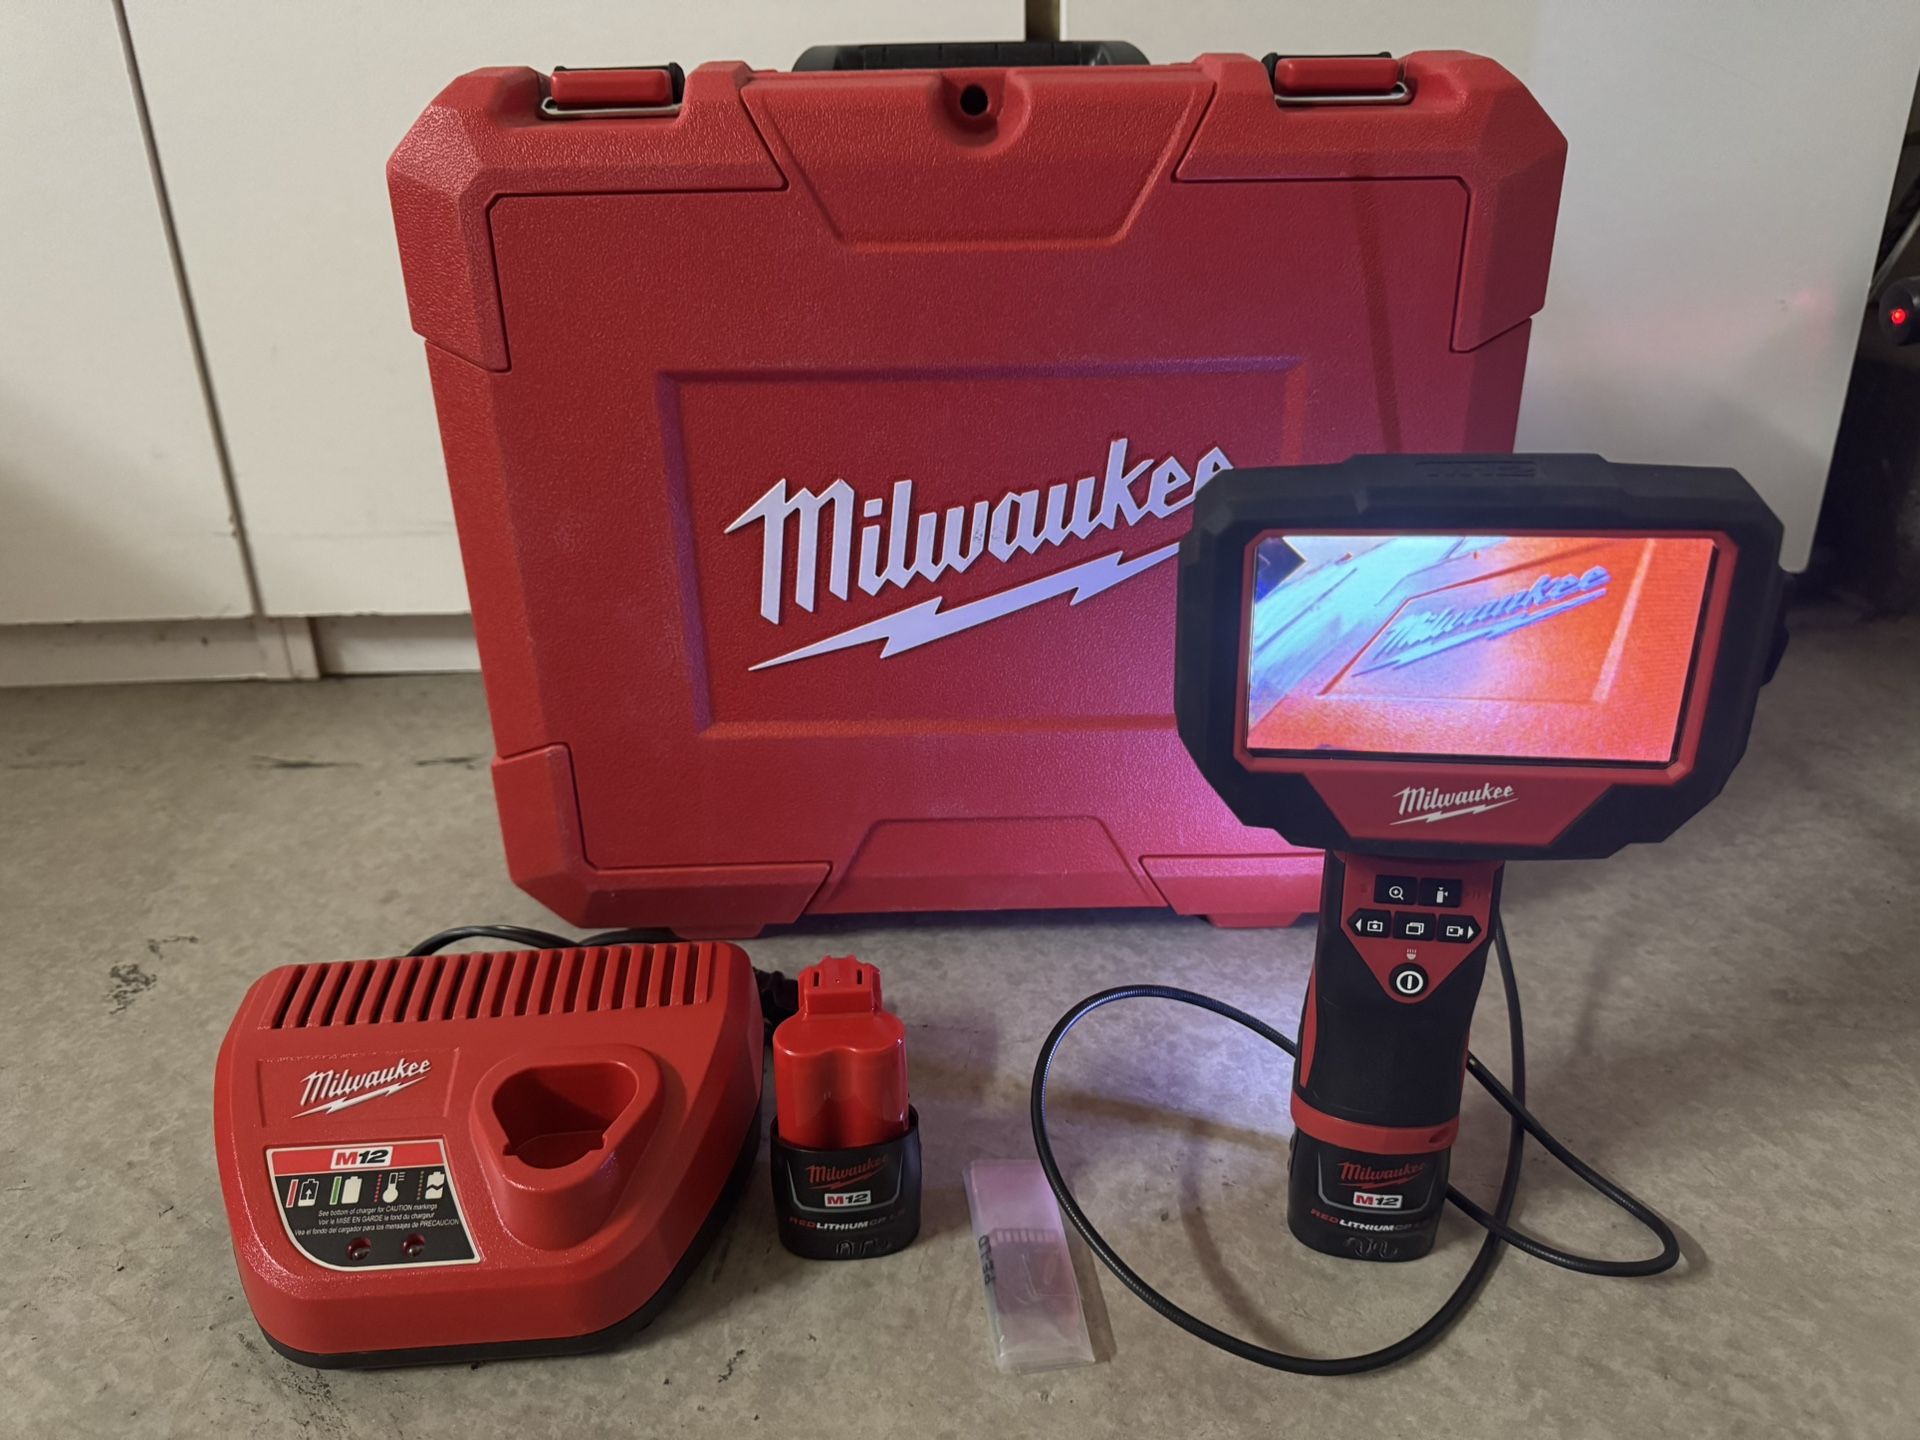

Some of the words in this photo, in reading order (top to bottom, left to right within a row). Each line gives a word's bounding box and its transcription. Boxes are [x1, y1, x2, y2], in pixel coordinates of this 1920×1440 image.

[1392, 782, 1515, 816] Milwaukee
[300, 1058, 431, 1106] Milwaukee
[335, 1149, 389, 1167] M12
[827, 1193, 869, 1205] M12
[1355, 1194, 1400, 1206] M12
[318, 1209, 329, 1217] See
[330, 1208, 349, 1216] bottom
[356, 1206, 376, 1215] charger
[386, 1204, 412, 1212] CAUTION
[413, 1203, 438, 1211] markings
[336, 1217, 351, 1225] MISE
[352, 1216, 361, 1224] EN
[362, 1214, 383, 1223] GARDE
[390, 1213, 403, 1221] fond
[312, 1227, 328, 1235] fondo
[338, 1226, 361, 1234] cargador
